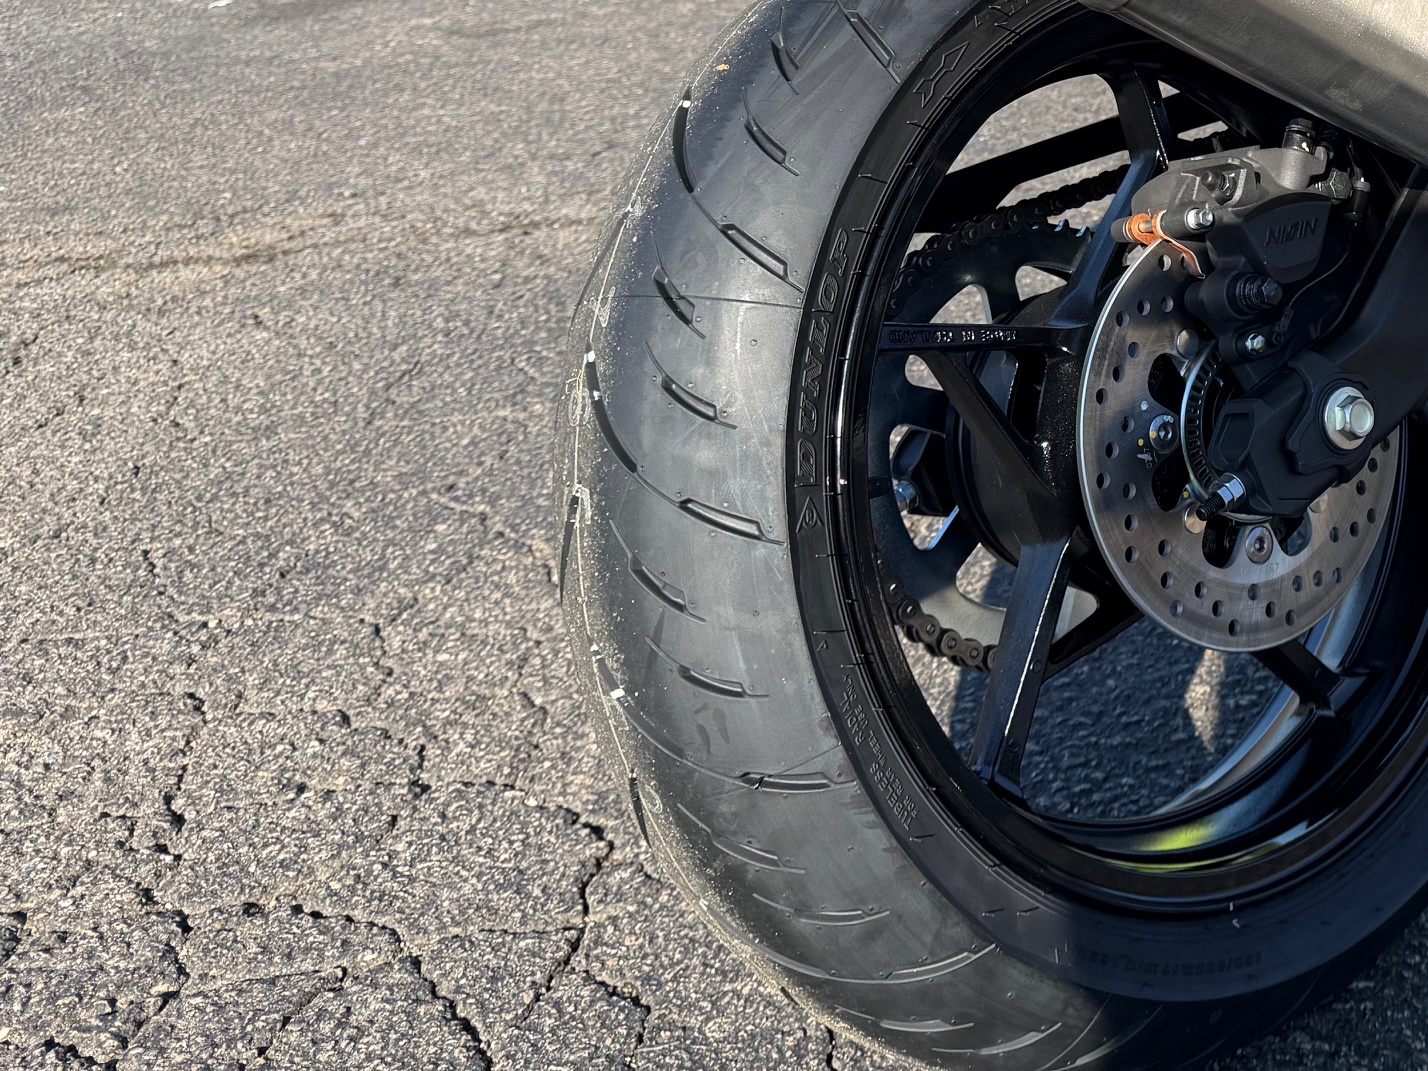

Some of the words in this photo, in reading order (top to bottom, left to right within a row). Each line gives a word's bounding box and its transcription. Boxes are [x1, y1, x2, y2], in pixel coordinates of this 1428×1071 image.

[797, 228, 850, 484] DUNLOP
[842, 673, 858, 702] ONLY
[840, 692, 865, 746] RADIAL
[854, 704, 869, 729] USE
[868, 730, 887, 767] WHEEL
[870, 762, 913, 831] TUBELESS
[885, 767, 904, 796] REAR
[903, 795, 918, 818] FOR
